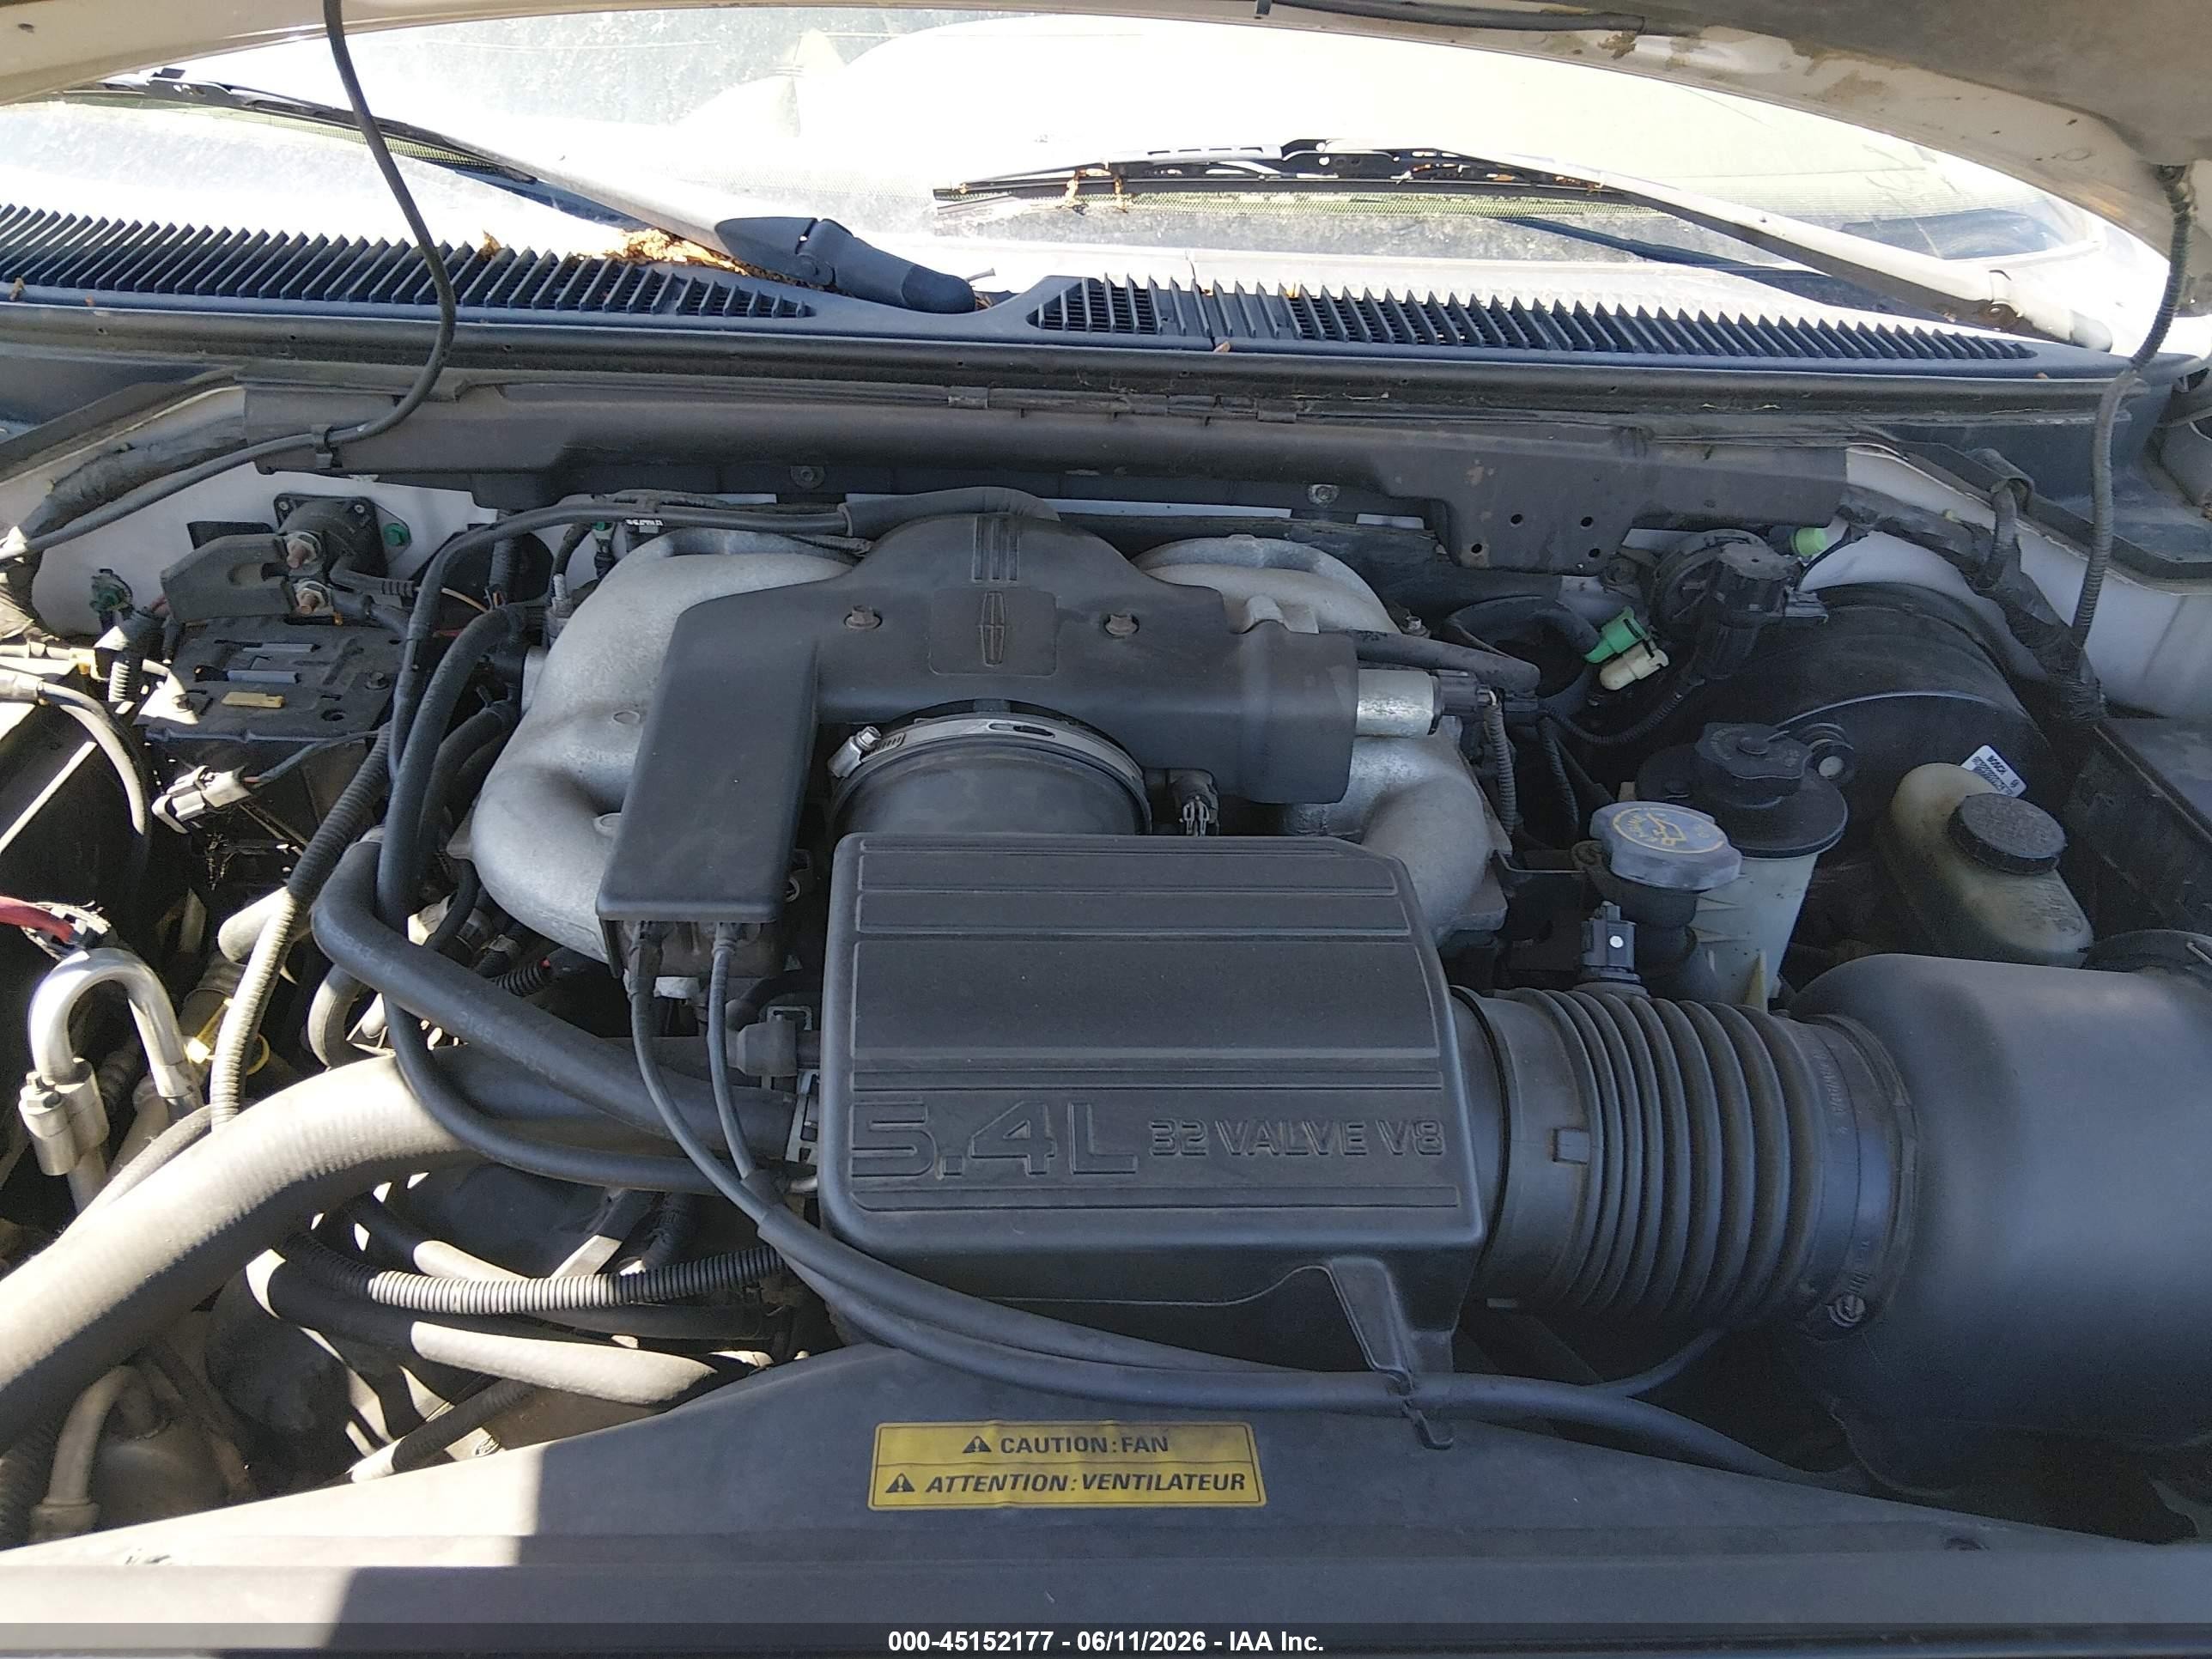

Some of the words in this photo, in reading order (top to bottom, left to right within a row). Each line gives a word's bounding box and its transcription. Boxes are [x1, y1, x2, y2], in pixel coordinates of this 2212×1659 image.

[849, 1100, 1138, 1179] 5.4L
[1150, 1119, 1208, 1157] 32
[1215, 1119, 1369, 1157] VALVE
[1375, 1118, 1445, 1157] V8
